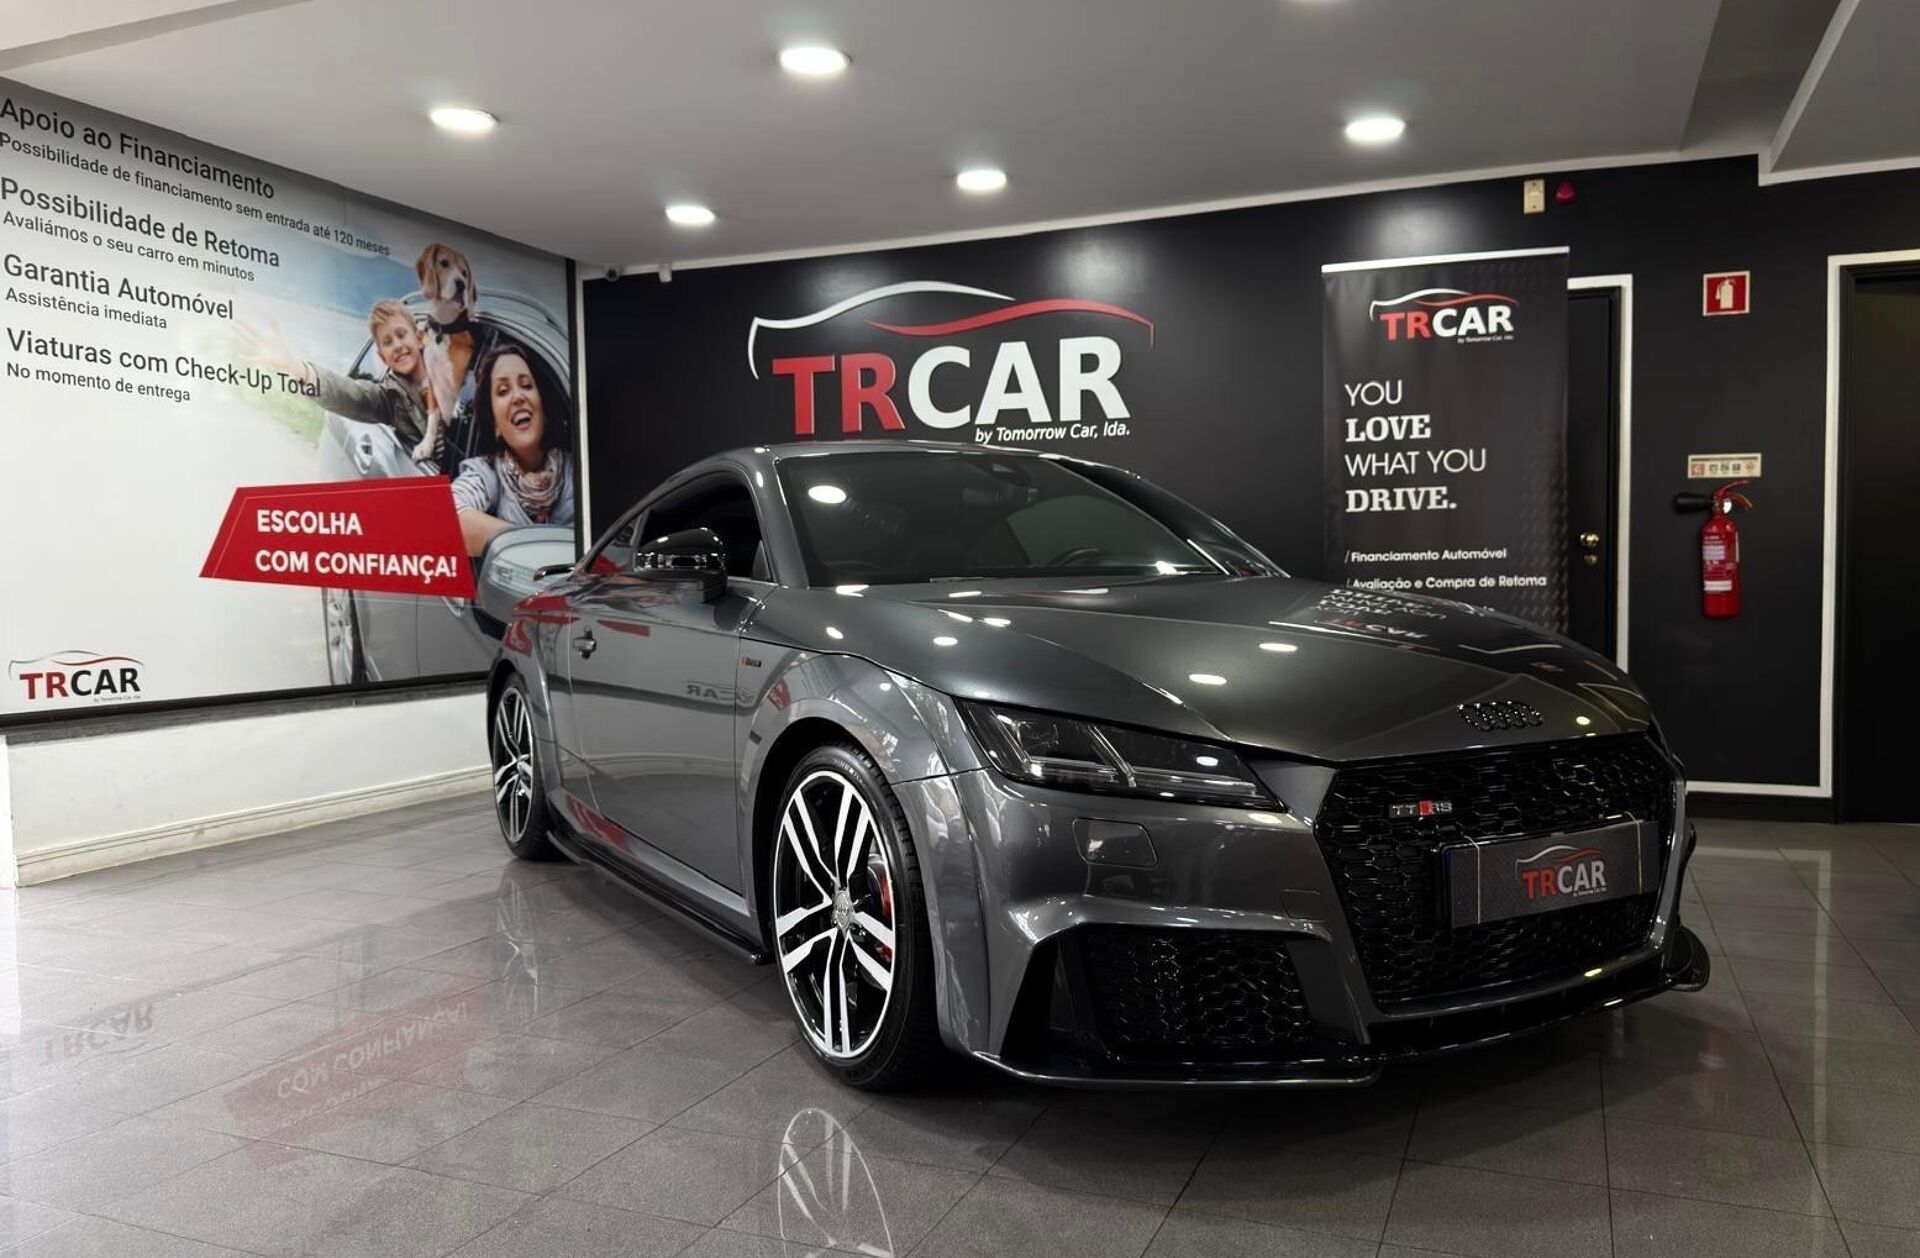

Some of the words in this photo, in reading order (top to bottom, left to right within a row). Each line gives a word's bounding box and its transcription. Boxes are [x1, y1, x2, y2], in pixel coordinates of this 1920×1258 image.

[0, 98, 75, 139] Apoio
[83, 127, 112, 150] ao
[120, 132, 275, 199] Financiamento
[0, 131, 108, 176] Possibilidade
[113, 166, 131, 181] de
[135, 171, 232, 211] financiamento
[236, 203, 262, 220] sem
[266, 212, 310, 233] entrada
[313, 225, 331, 239] até
[334, 229, 353, 246] 120
[356, 237, 391, 256] meses
[1, 177, 165, 239] Possibilidade
[172, 222, 198, 247] de
[204, 230, 280, 267] Retoma
[3, 210, 89, 244] Avaliámos
[93, 235, 102, 246] o
[107, 238, 134, 253] seu
[138, 246, 174, 263] carro
[178, 255, 199, 269] em
[203, 260, 255, 282] minutos
[4, 254, 110, 295] Garantia
[118, 278, 234, 320] Automóvel
[5, 287, 100, 317] Assistência
[104, 305, 168, 329] imediata
[1380, 305, 1514, 341] TRCAR
[6, 327, 112, 365] Viaturas
[120, 352, 168, 374] com
[175, 356, 273, 394] Check-Up
[277, 372, 321, 397] Total
[7, 362, 30, 379] No
[36, 369, 111, 390] momento
[115, 378, 134, 393] de
[138, 384, 190, 403] entrega
[772, 336, 1131, 436] TRCAR
[1345, 379, 1403, 407] YOU
[975, 427, 993, 445] by
[996, 426, 1067, 441] Tomorrow
[1070, 424, 1099, 439] Car,
[1345, 414, 1431, 443] LOVE
[1345, 451, 1420, 477] WHAT
[1427, 448, 1488, 475] YOU
[1346, 486, 1457, 513] DRIVE.
[256, 509, 363, 536] ESCOLHA
[255, 550, 309, 573] COM
[315, 552, 458, 584] CONFIANÇA!
[1351, 550, 1440, 562] Financiamento
[1442, 547, 1507, 560] Automóvel
[1352, 578, 1412, 592] Avaliação
[1414, 580, 1423, 589] e
[1425, 577, 1475, 590] Compra
[1479, 576, 1495, 587] de
[1499, 575, 1547, 587] Retoma
[19, 668, 141, 700] TRCAR
[1522, 861, 1606, 899] TRCAR
